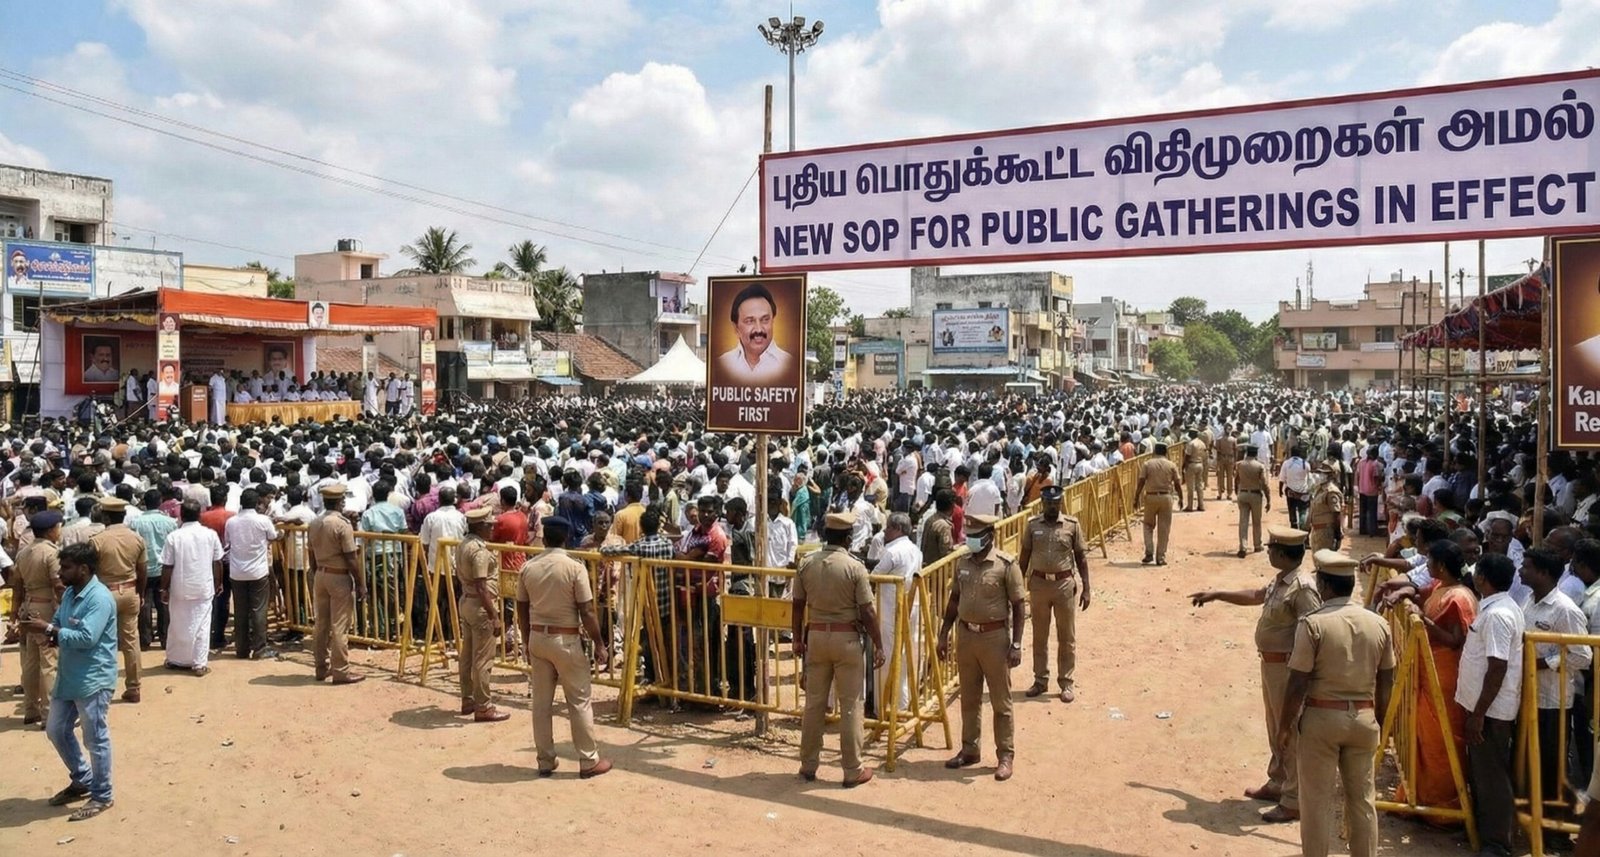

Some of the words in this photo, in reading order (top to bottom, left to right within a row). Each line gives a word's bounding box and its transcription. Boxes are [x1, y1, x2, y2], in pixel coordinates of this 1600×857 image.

[773, 162, 847, 212] புதிய
[855, 145, 1095, 203] பொதுக்கூட்ட
[1104, 105, 1425, 186] விதிமுறைகள்
[1437, 88, 1595, 152] அமல்
[773, 222, 834, 257] NEW
[842, 218, 900, 254] SOP
[910, 213, 972, 250] FOR
[981, 204, 1104, 247] PUBLIC
[1114, 187, 1361, 239] GATHERINGS
[1374, 183, 1416, 225] IN
[1431, 171, 1596, 222] EFFECT
[712, 386, 752, 402] PUBLIC
[754, 387, 798, 403] SAFETY
[738, 406, 770, 422] FIRST
